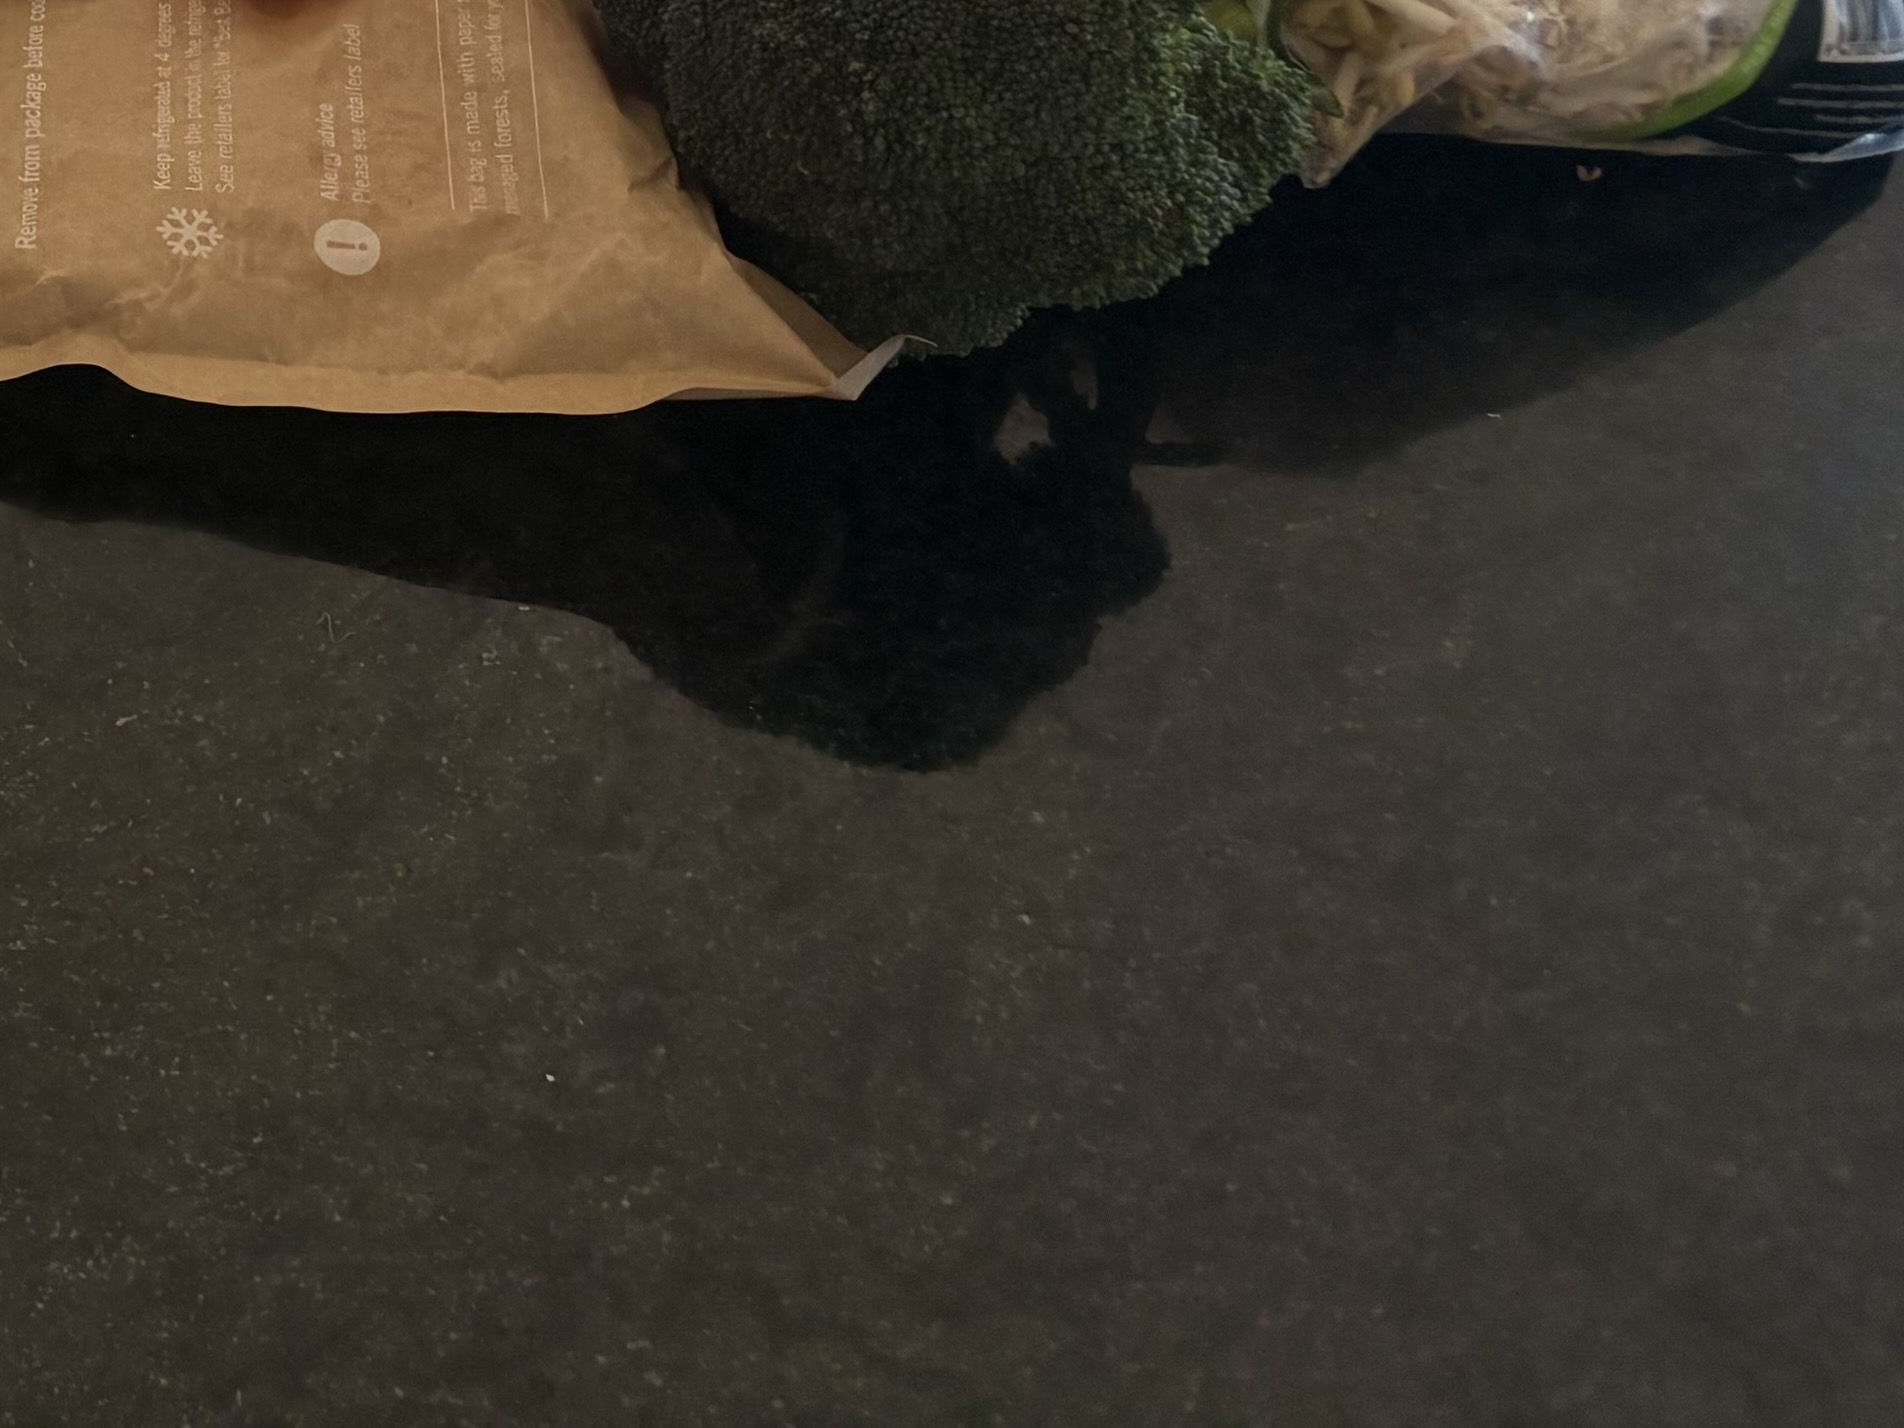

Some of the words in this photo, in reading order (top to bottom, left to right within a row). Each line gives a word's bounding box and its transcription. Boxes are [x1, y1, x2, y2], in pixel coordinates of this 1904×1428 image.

[22, 17, 45, 67] before
[154, 1, 174, 48] degrees
[343, 24, 362, 61] label
[456, 7, 480, 46] paper
[154, 52, 171, 64] 4
[155, 65, 172, 80] at
[456, 53, 480, 86] with
[485, 31, 505, 83] sealed
[213, 64, 232, 97] label
[344, 64, 366, 123] retailers
[20, 72, 47, 140] package
[319, 103, 334, 148] advice
[460, 90, 482, 140] made
[493, 88, 513, 150] forests,
[184, 126, 203, 146] the
[214, 101, 234, 161] retailers
[351, 126, 367, 152] see
[464, 139, 482, 153] is
[19, 143, 41, 184] from
[153, 151, 176, 191] Keep
[184, 149, 204, 192] Leave
[215, 163, 235, 194] See
[320, 148, 342, 202] Allergy
[352, 153, 372, 204] Please
[466, 156, 488, 183] bag
[15, 185, 41, 250] Remove
[470, 184, 489, 214] This
